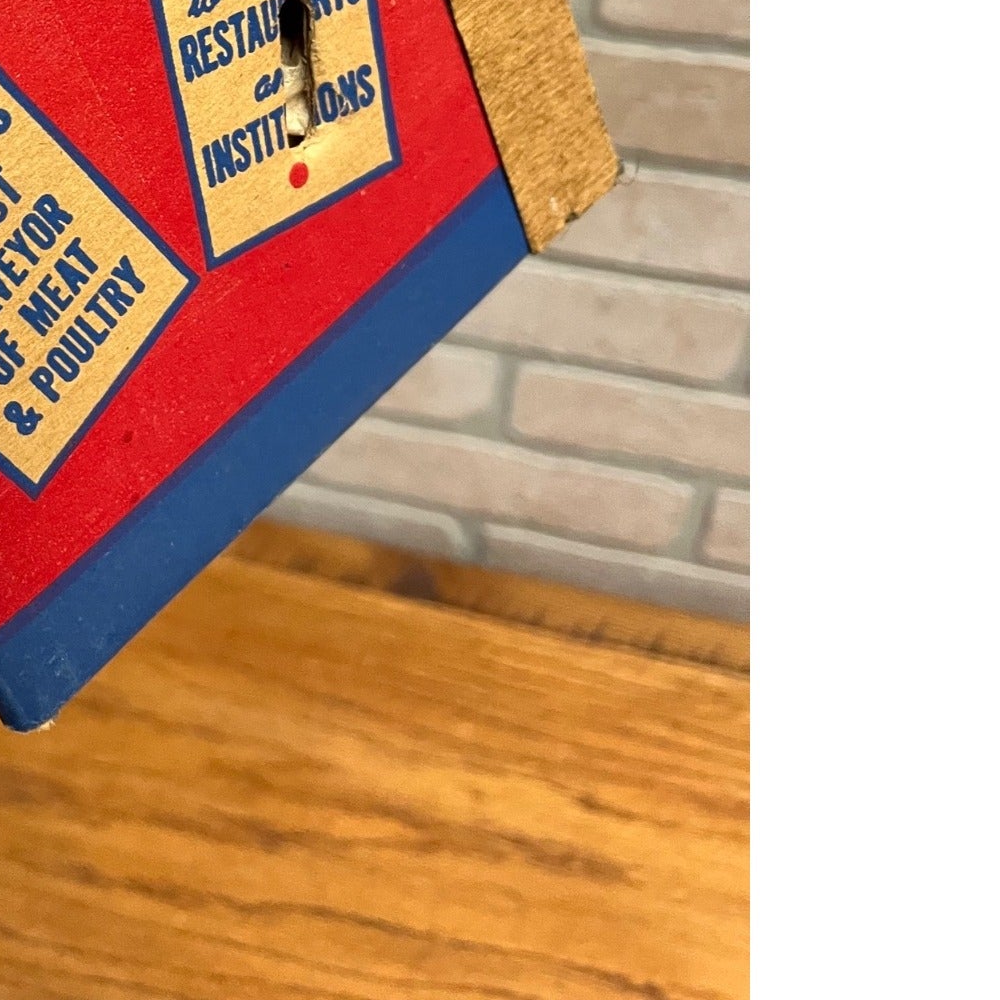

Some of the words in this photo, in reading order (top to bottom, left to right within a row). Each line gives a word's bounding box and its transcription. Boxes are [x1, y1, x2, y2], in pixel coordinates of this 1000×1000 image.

[201, 64, 376, 188] INSTITONS
[2, 401, 44, 436] &
[28, 255, 146, 404] POULTRY
[17, 236, 99, 337] MEAT
